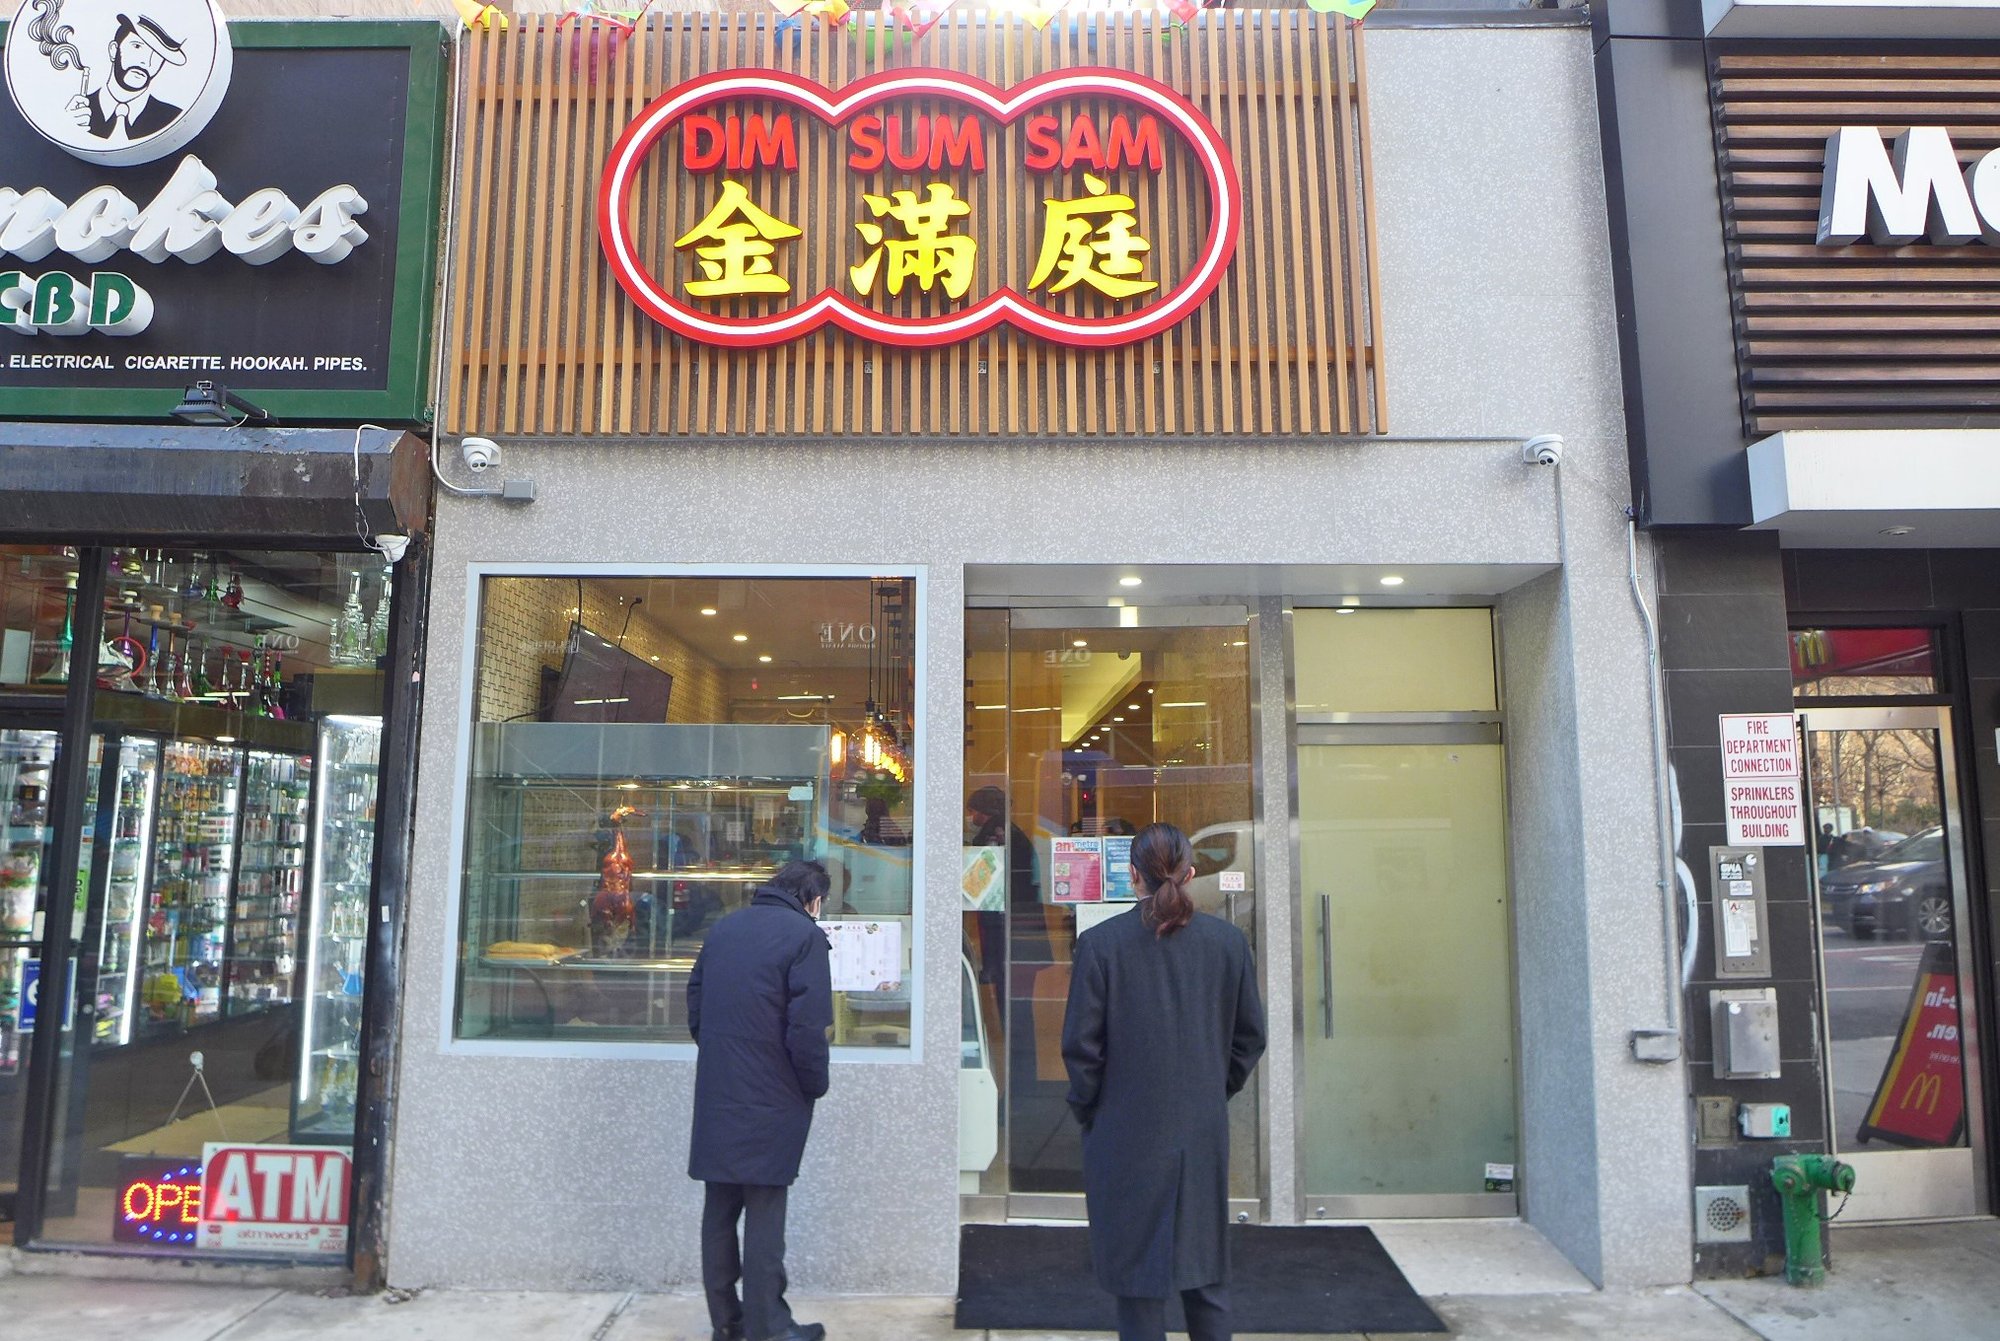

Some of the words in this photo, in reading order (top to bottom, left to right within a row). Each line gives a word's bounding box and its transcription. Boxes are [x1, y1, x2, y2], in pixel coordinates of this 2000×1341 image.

[683, 114, 798, 174] DIM
[848, 116, 985, 173] SUM
[1024, 114, 1164, 173] SAM
[1828, 126, 2000, 242] M
[674, 173, 1159, 302] 金滿庭
[0, 271, 142, 328] CBD
[10, 355, 114, 369] ELECTRICAL
[125, 356, 226, 370] CIGARETTE.
[230, 356, 308, 370] HOOKAH.
[313, 357, 368, 371] PIPES.
[1747, 720, 1769, 735] FIRE
[1726, 739, 1792, 754] DEPARTMENT
[1731, 758, 1792, 773] CONNECTION
[1731, 787, 1795, 801] SPRINKLERS
[1730, 805, 1797, 820] THROUGHOUT
[1742, 823, 1789, 838] BUILDING
[211, 1152, 344, 1222] ATM
[124, 1182, 202, 1222] OPE
